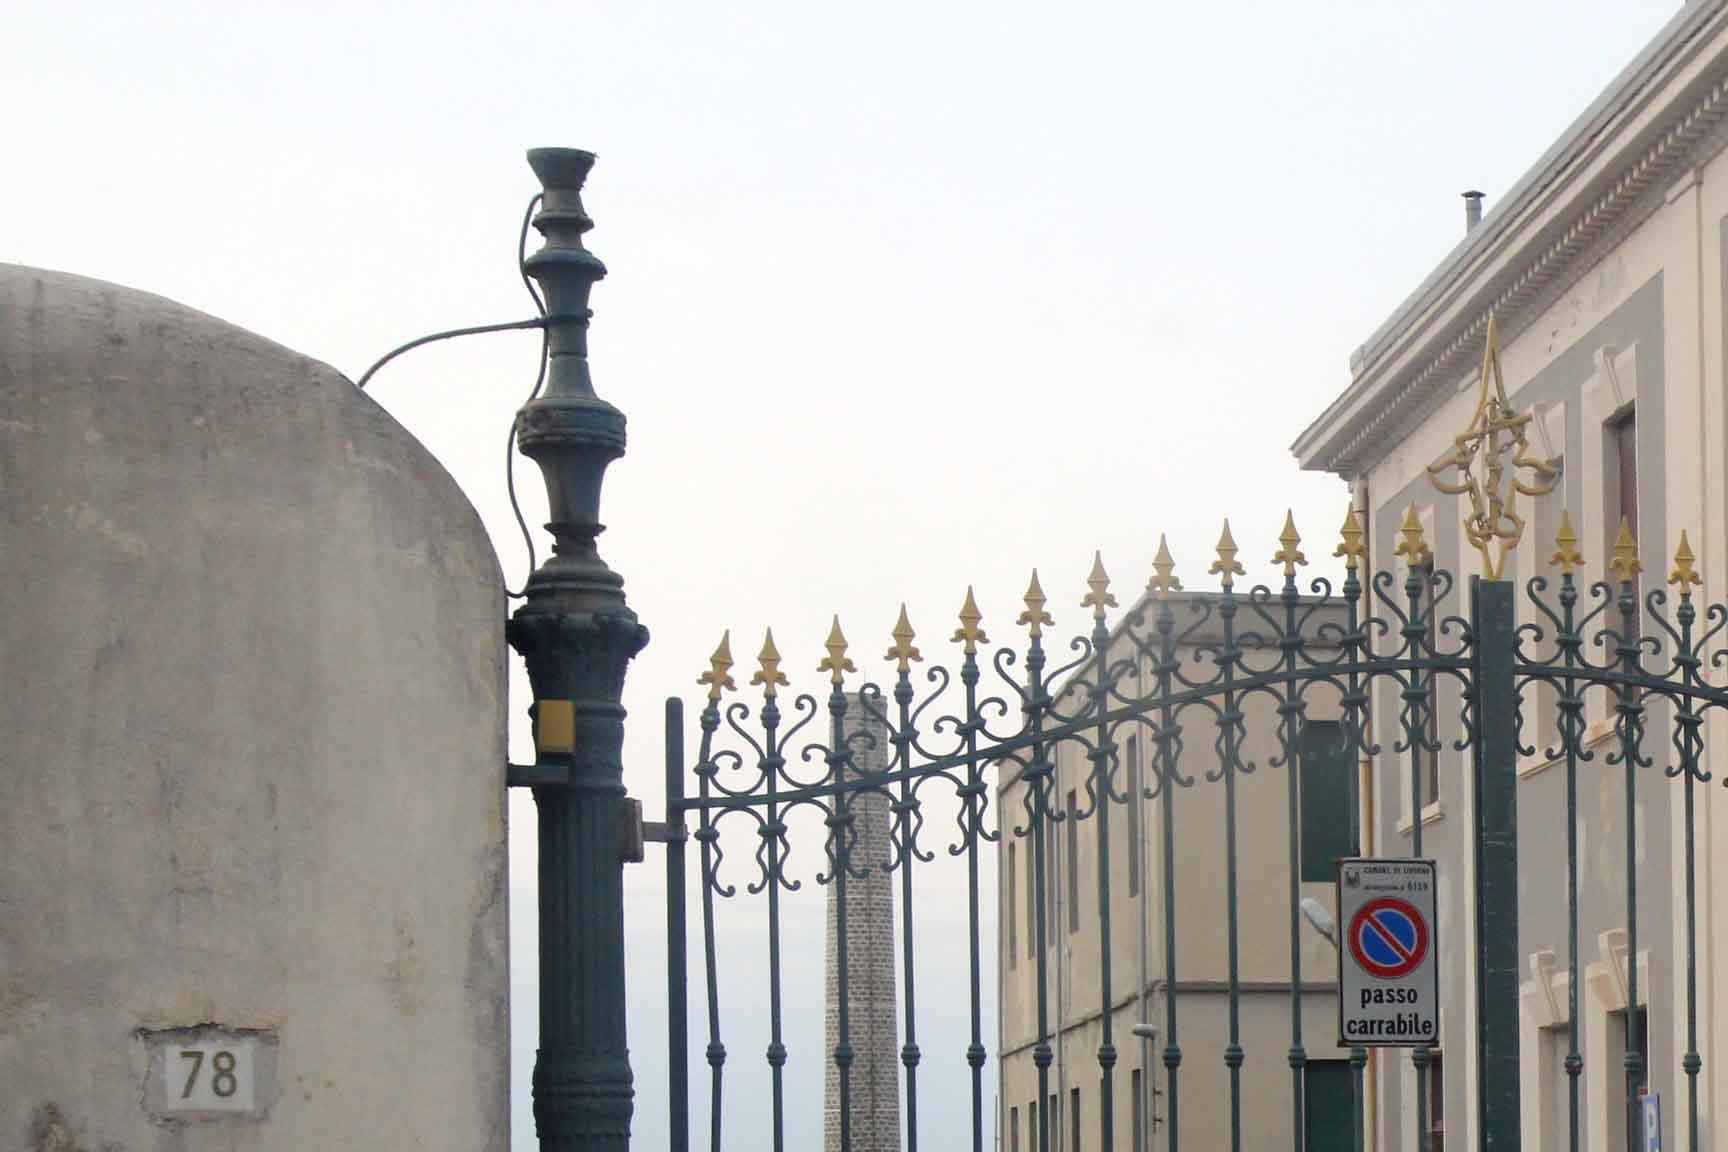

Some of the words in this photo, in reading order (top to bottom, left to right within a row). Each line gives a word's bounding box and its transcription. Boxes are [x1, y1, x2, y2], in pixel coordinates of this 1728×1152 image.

[1360, 987, 1418, 1009] passo
[1346, 1015, 1433, 1036] carrabile
[181, 1051, 237, 1099] 78
